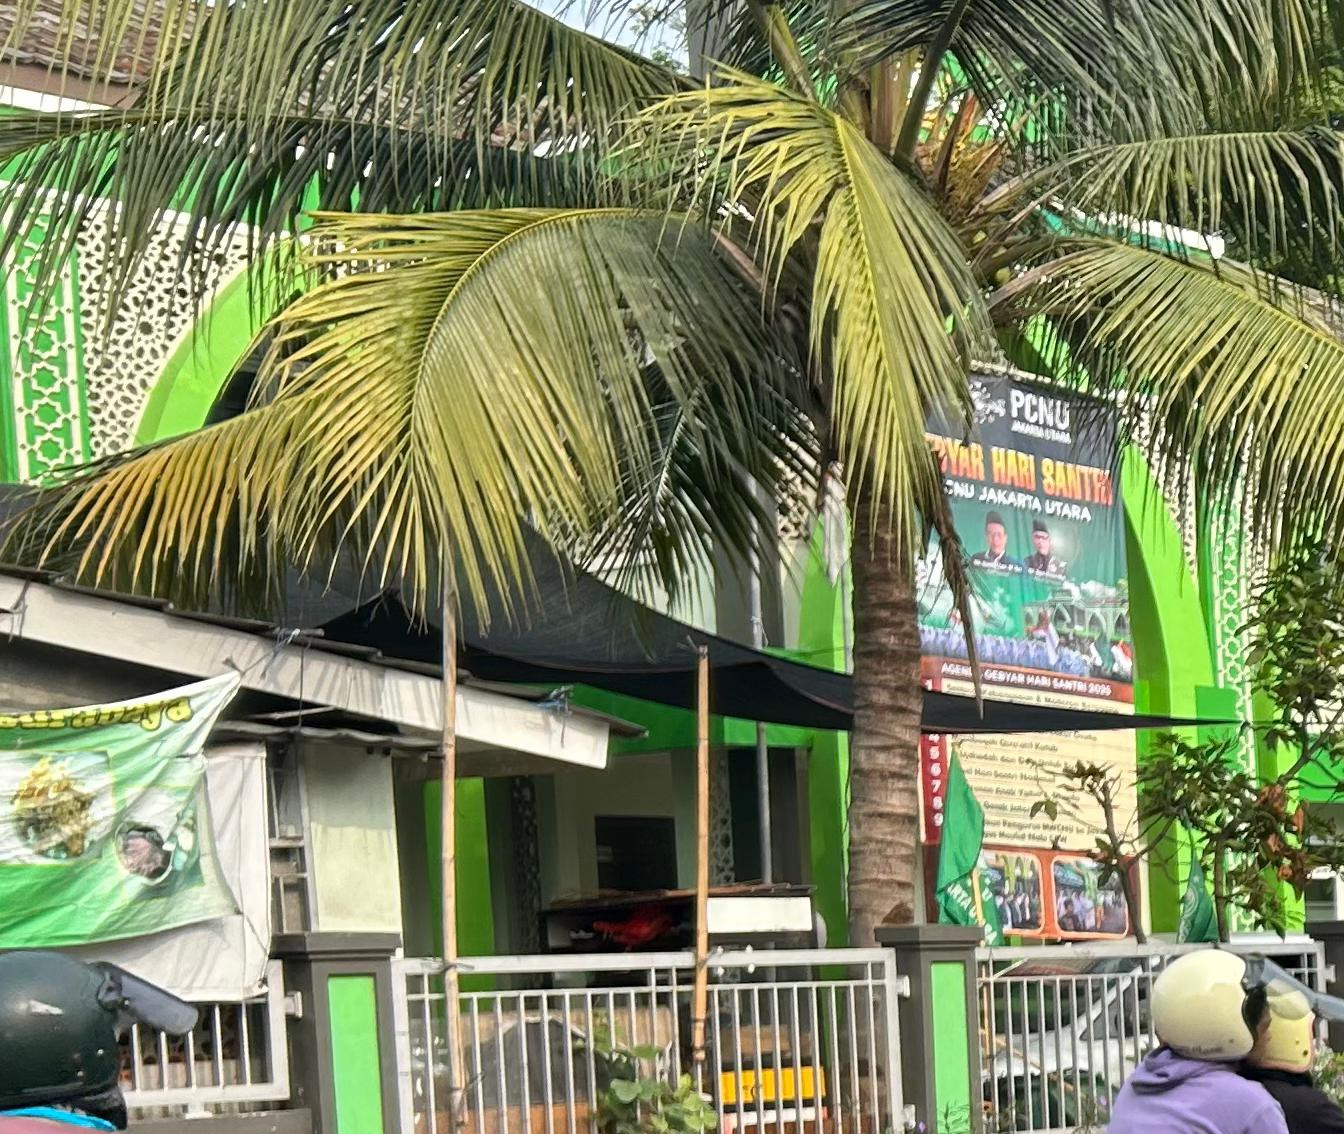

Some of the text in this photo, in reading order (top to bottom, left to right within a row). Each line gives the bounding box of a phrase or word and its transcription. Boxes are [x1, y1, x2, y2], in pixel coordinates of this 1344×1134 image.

[1010, 389, 1070, 430] PCNU
[991, 446, 1036, 492] HARI
[1041, 457, 1113, 507] SANTRI
[943, 479, 1092, 522] CNU JAKARTA UTARA
